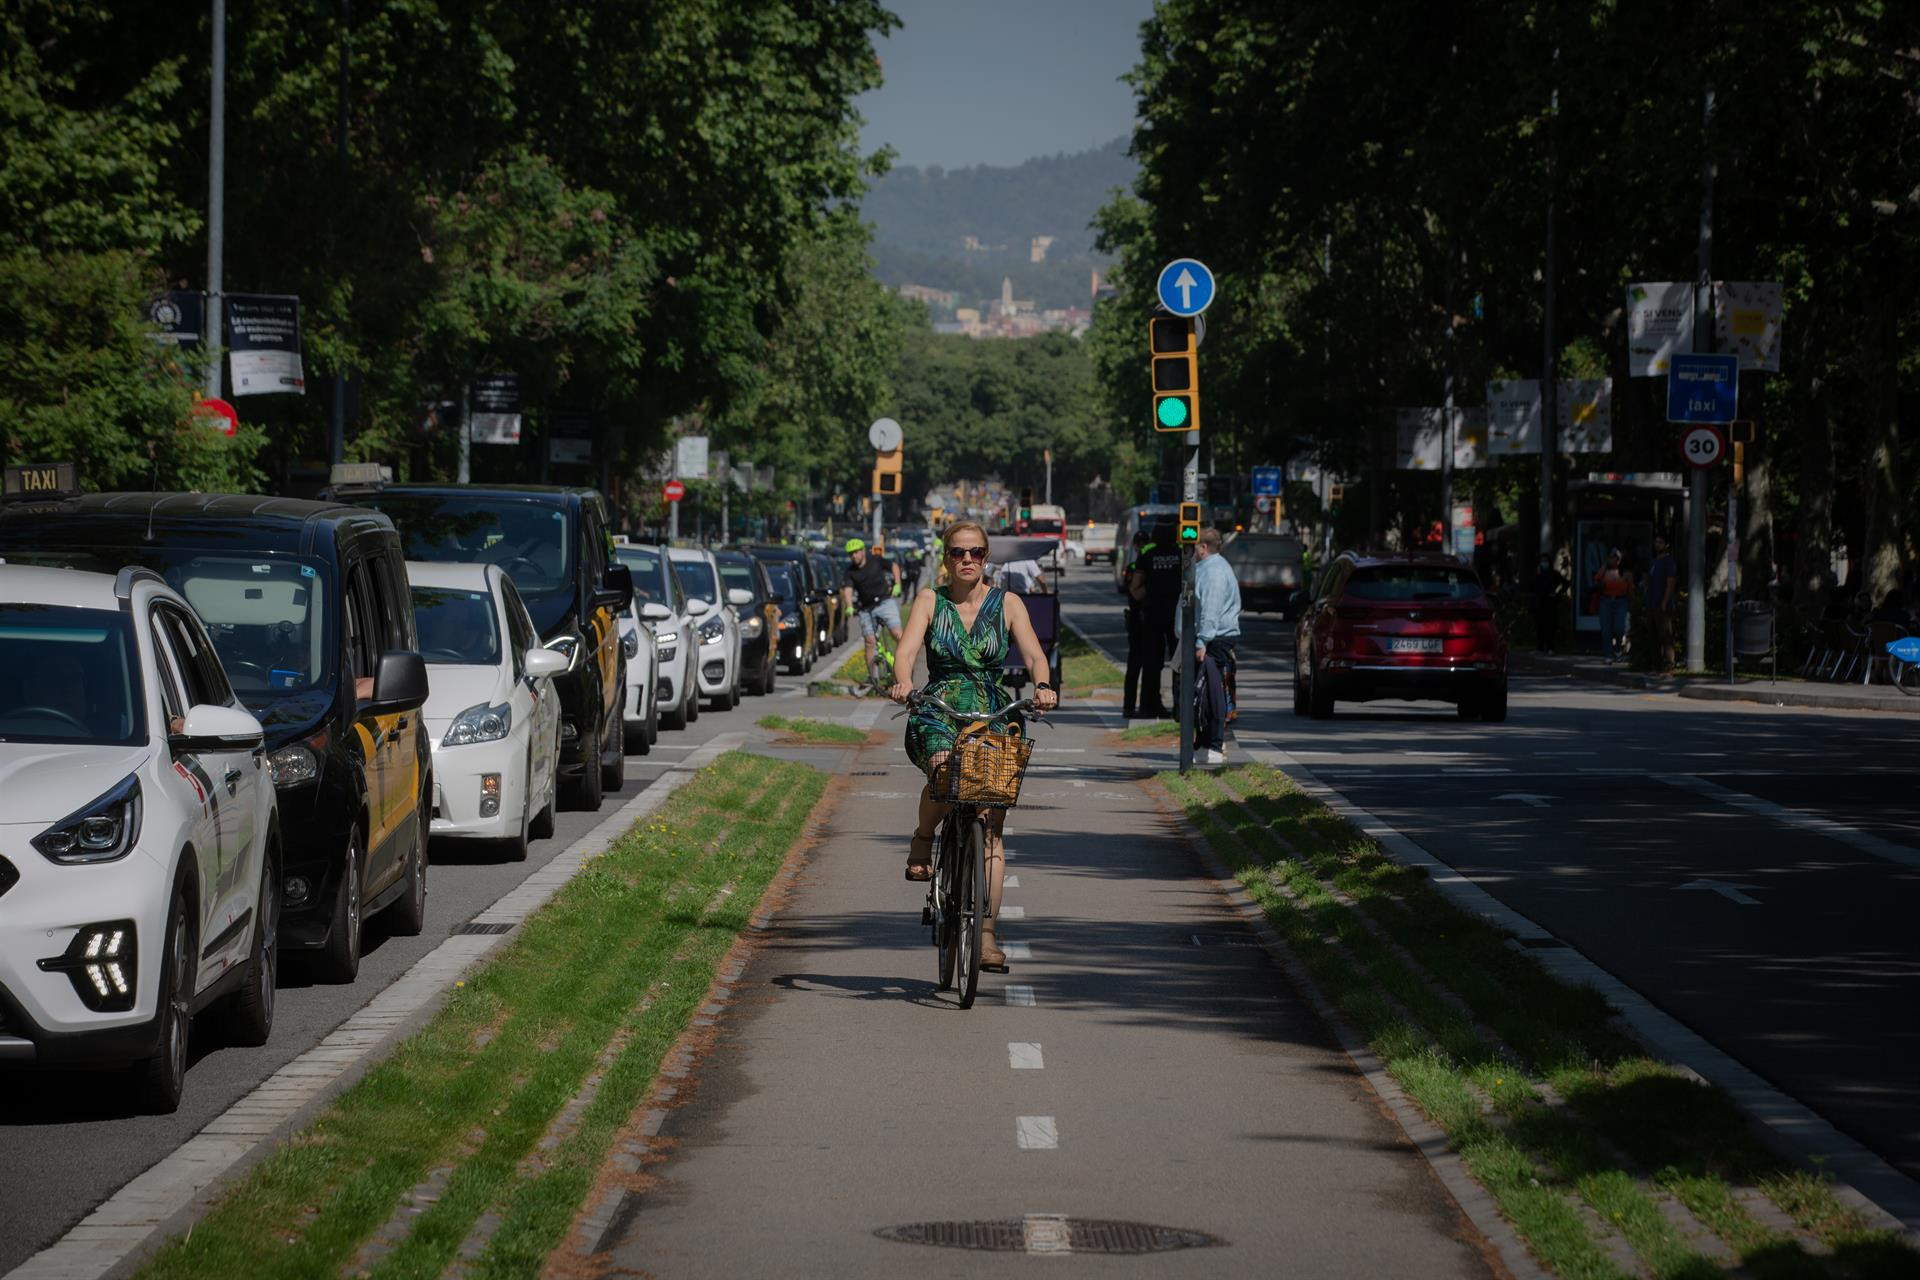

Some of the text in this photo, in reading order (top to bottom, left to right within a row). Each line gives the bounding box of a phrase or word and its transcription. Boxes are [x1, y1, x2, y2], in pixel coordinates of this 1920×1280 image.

[1688, 398, 1716, 412] taxi
[1690, 439, 1715, 454] 30
[21, 469, 57, 490] TAXI
[1393, 639, 1418, 649] 2469
